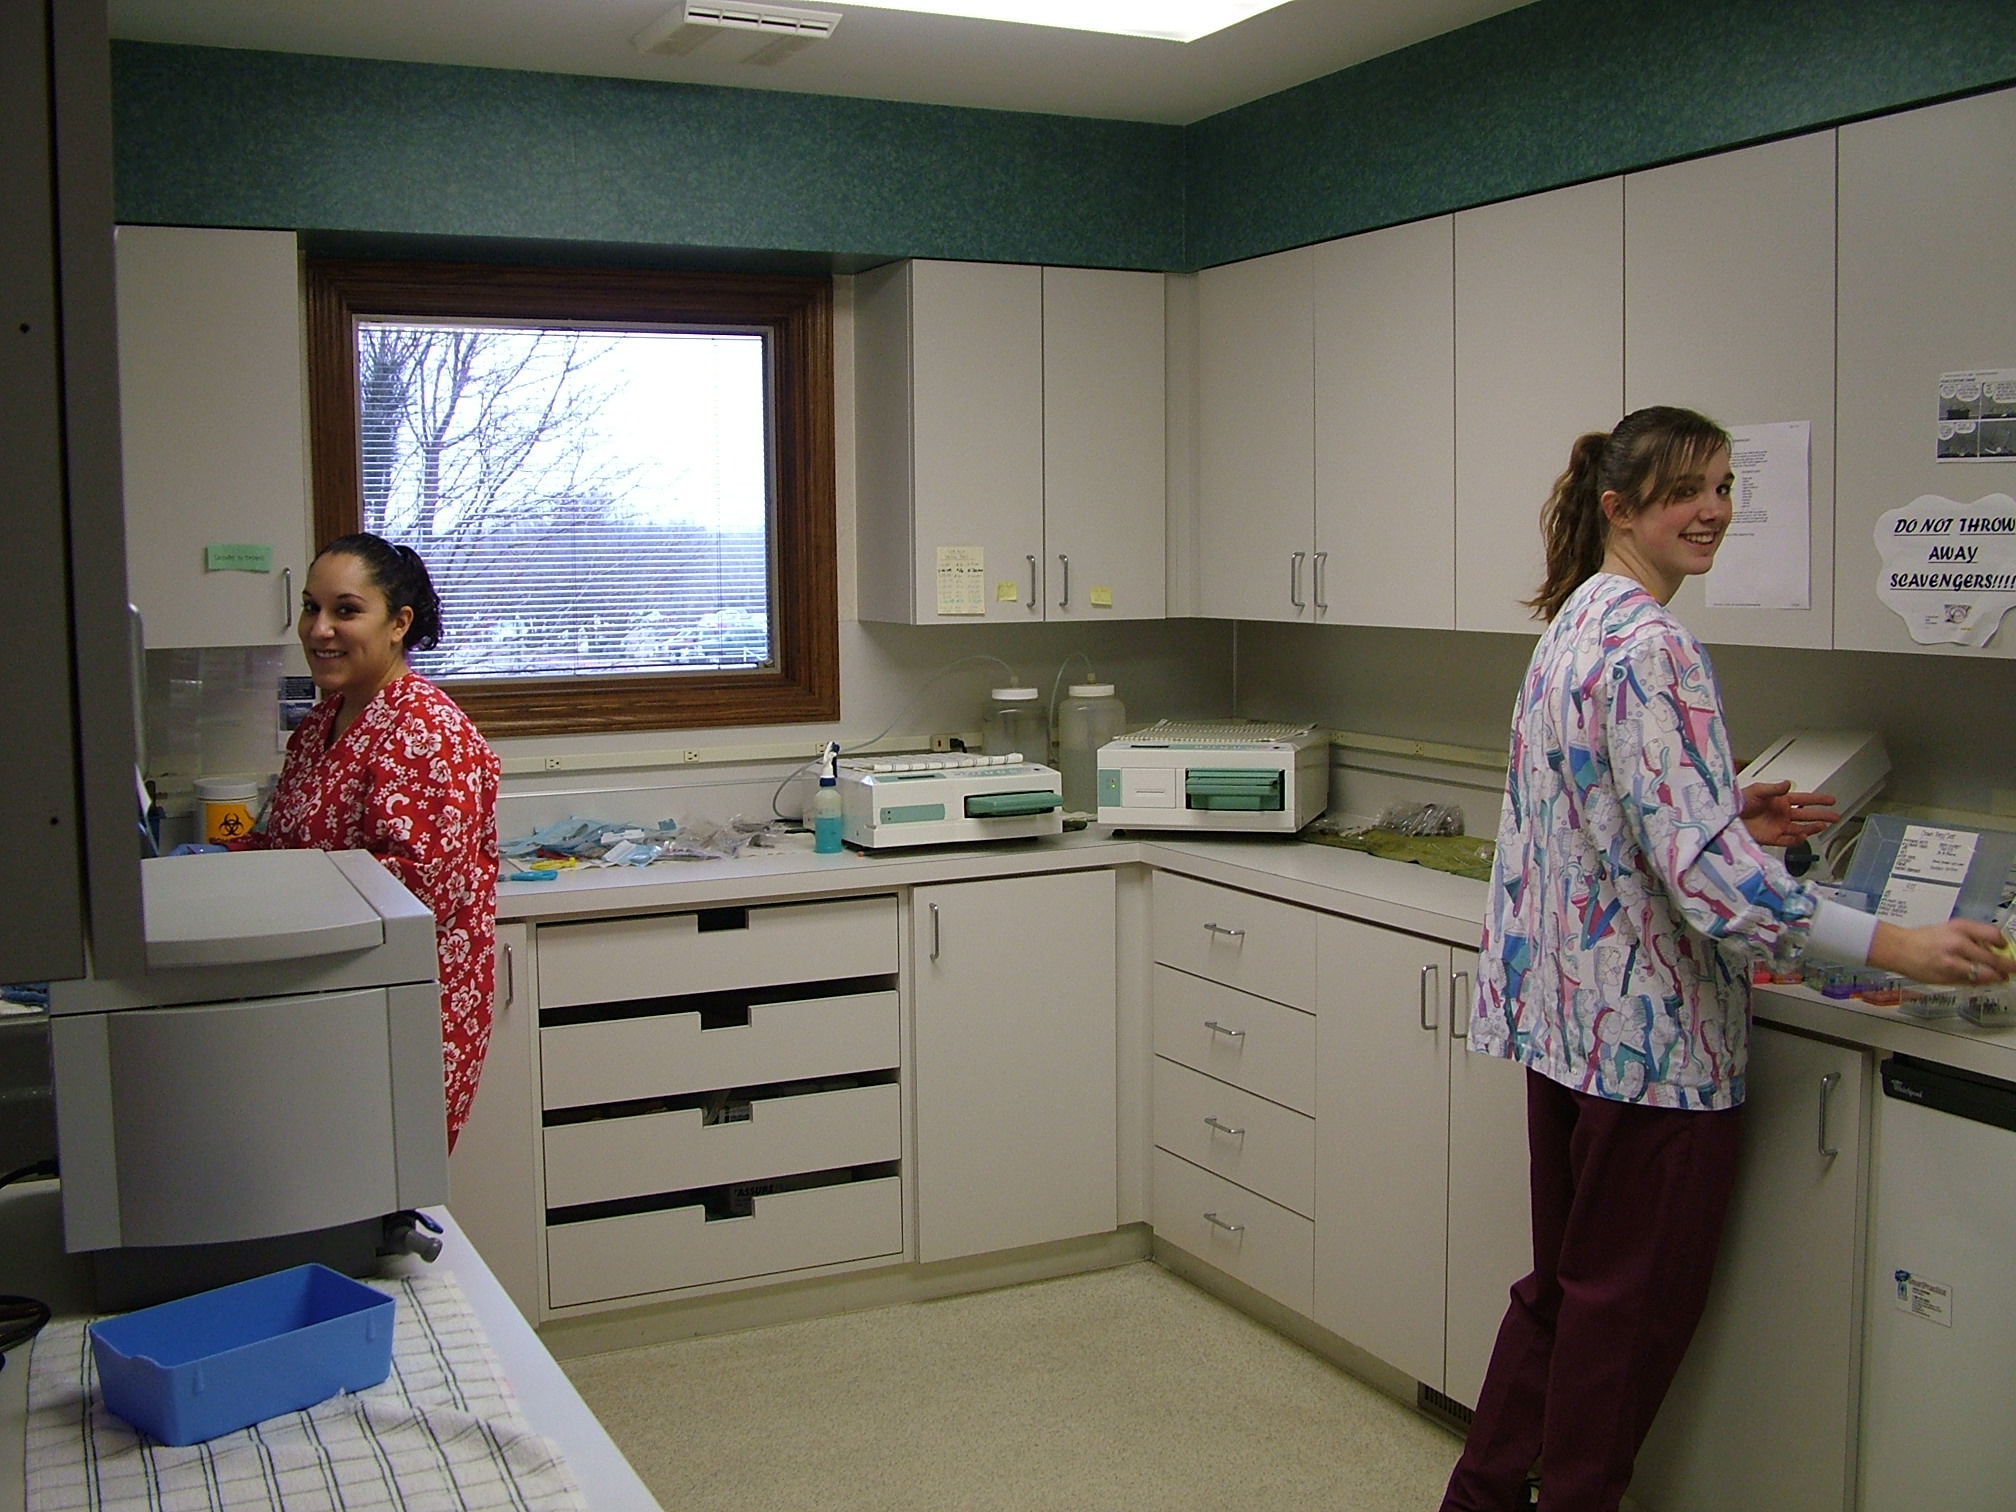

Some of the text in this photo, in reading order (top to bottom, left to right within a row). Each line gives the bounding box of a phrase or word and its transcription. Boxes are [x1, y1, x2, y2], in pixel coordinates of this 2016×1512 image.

[1894, 517, 2016, 533] DO NOT THROW
[1928, 545, 1979, 563] AWAY
